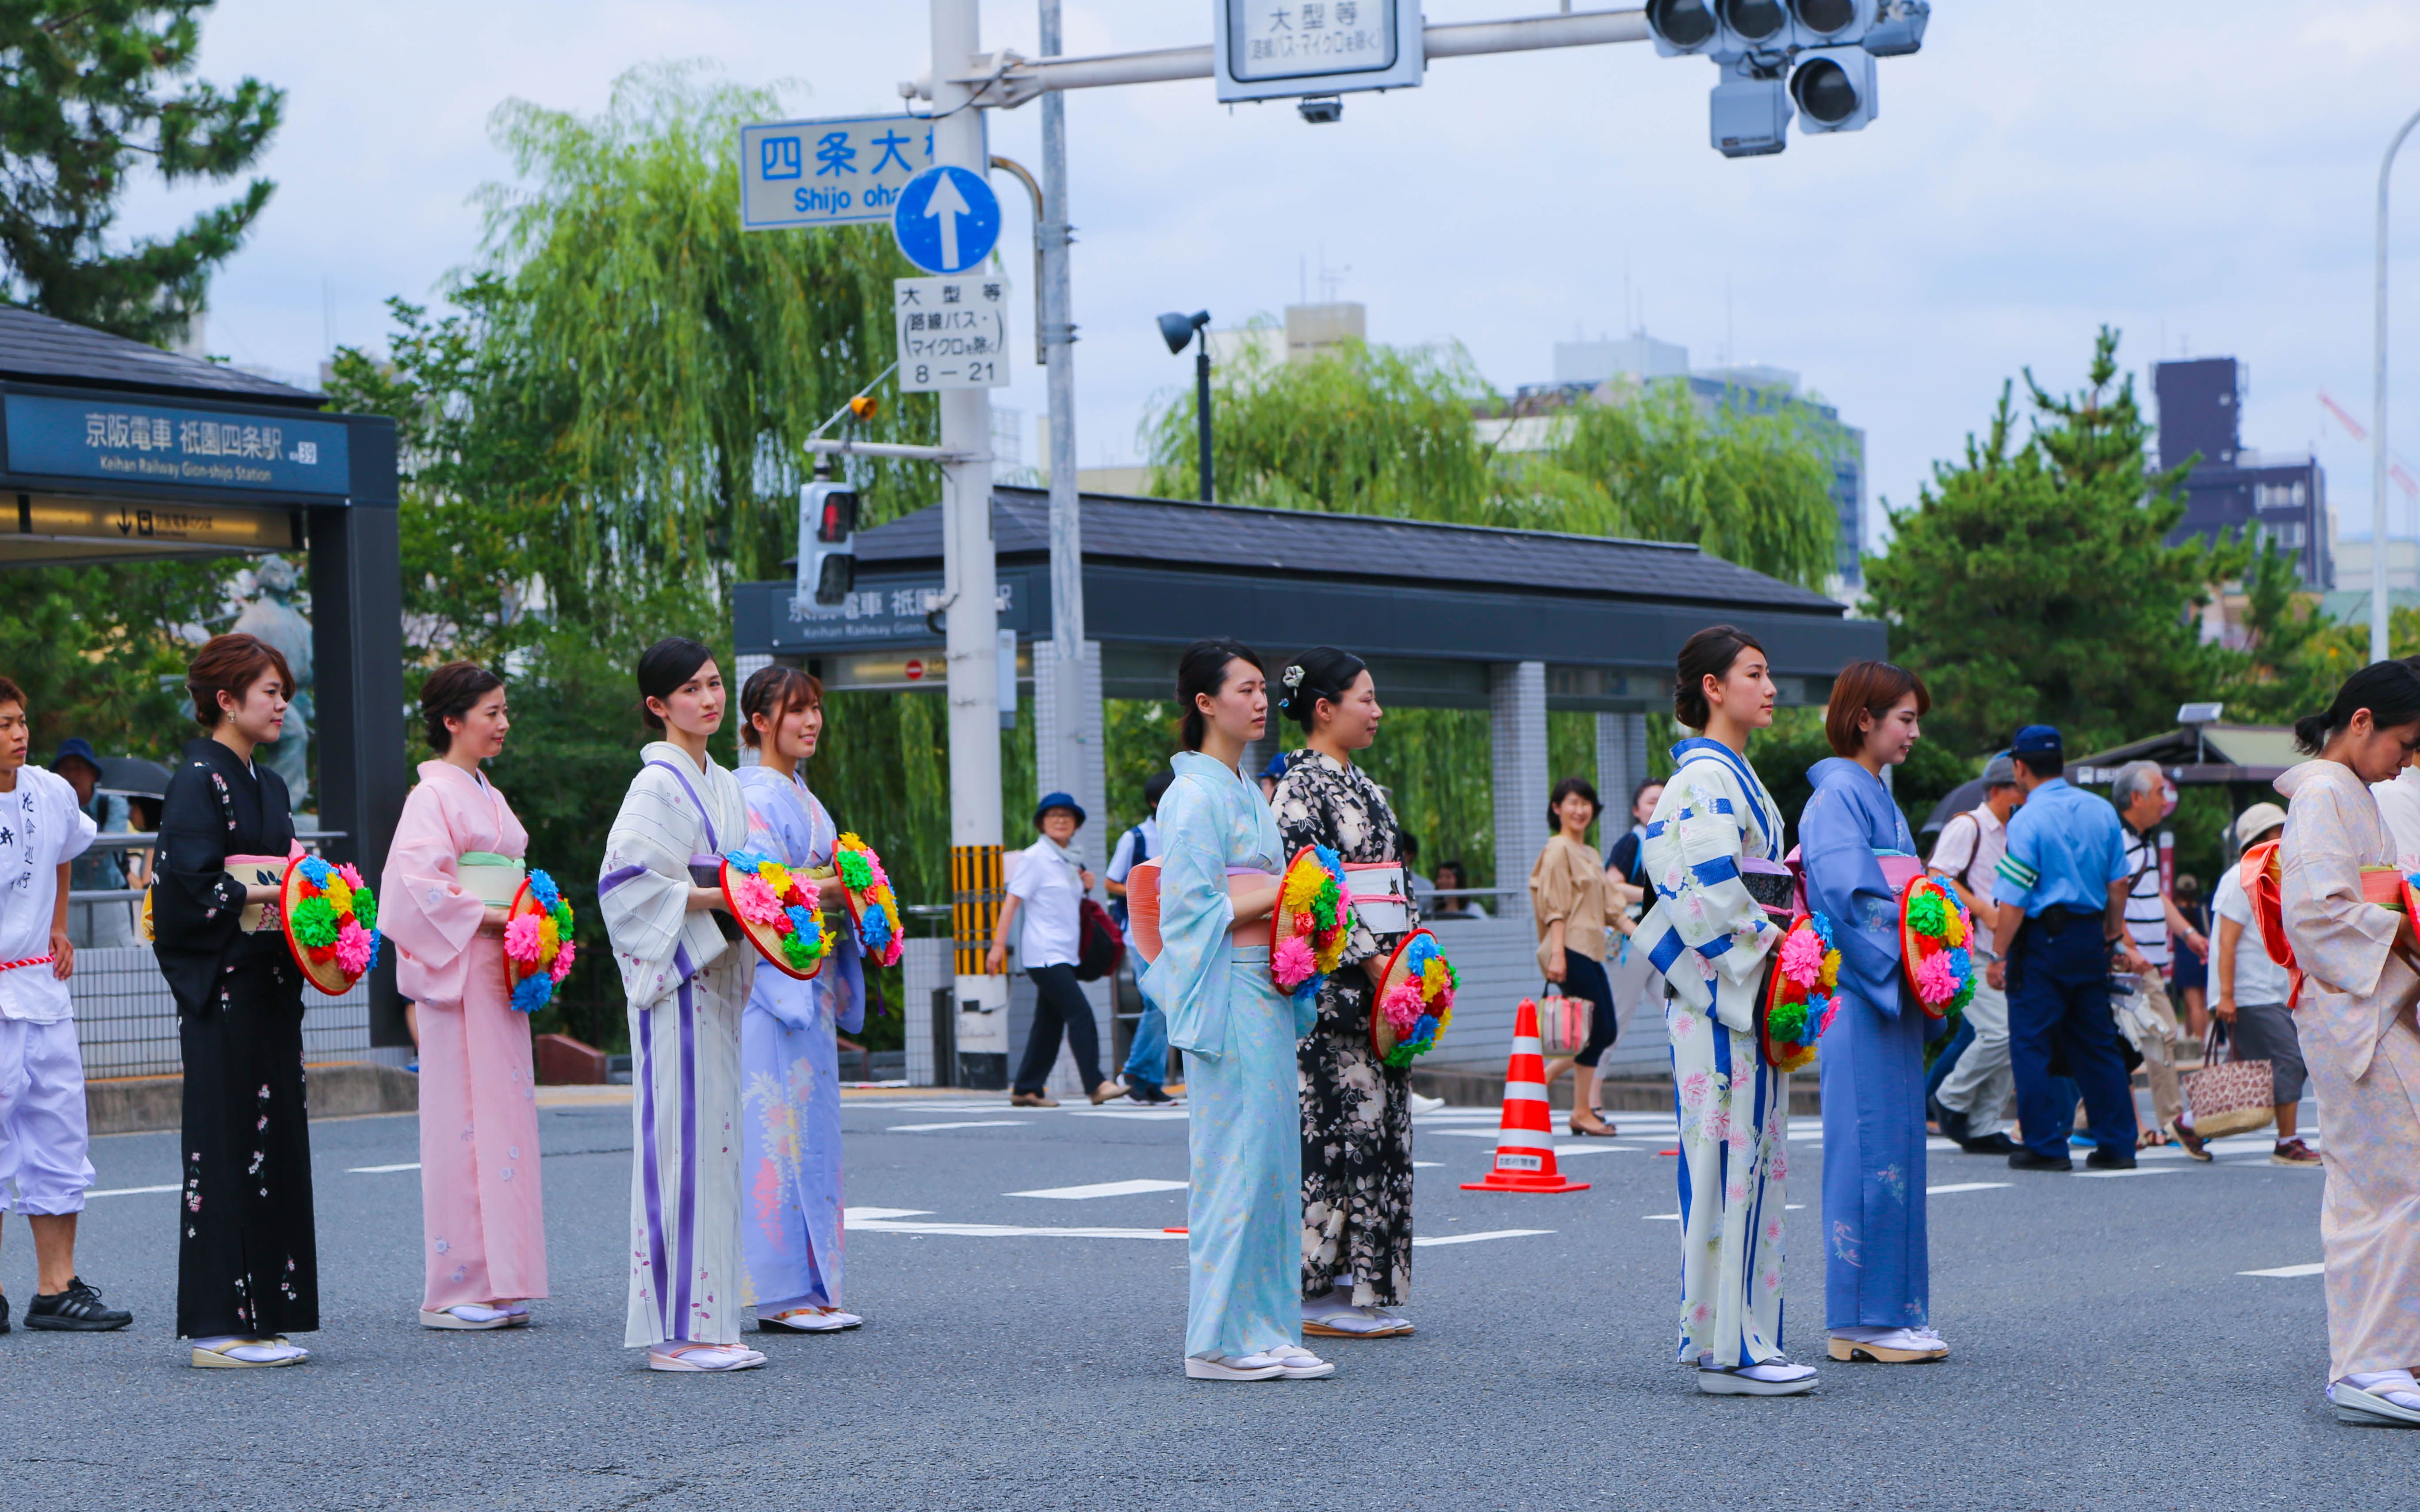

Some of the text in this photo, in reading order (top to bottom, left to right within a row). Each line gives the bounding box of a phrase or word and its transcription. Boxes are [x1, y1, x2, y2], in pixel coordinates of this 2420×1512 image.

[1269, 1, 1357, 32] 大型等
[762, 128, 932, 180] 四条大
[794, 183, 900, 214] Shijo oha
[901, 284, 1001, 305] 大型等
[85, 412, 283, 460] 京阪電車 祇園四条駅
[100, 455, 272, 482] Keihan Railway Gion-shijo Station
[17, 792, 36, 888] 花傘巡行
